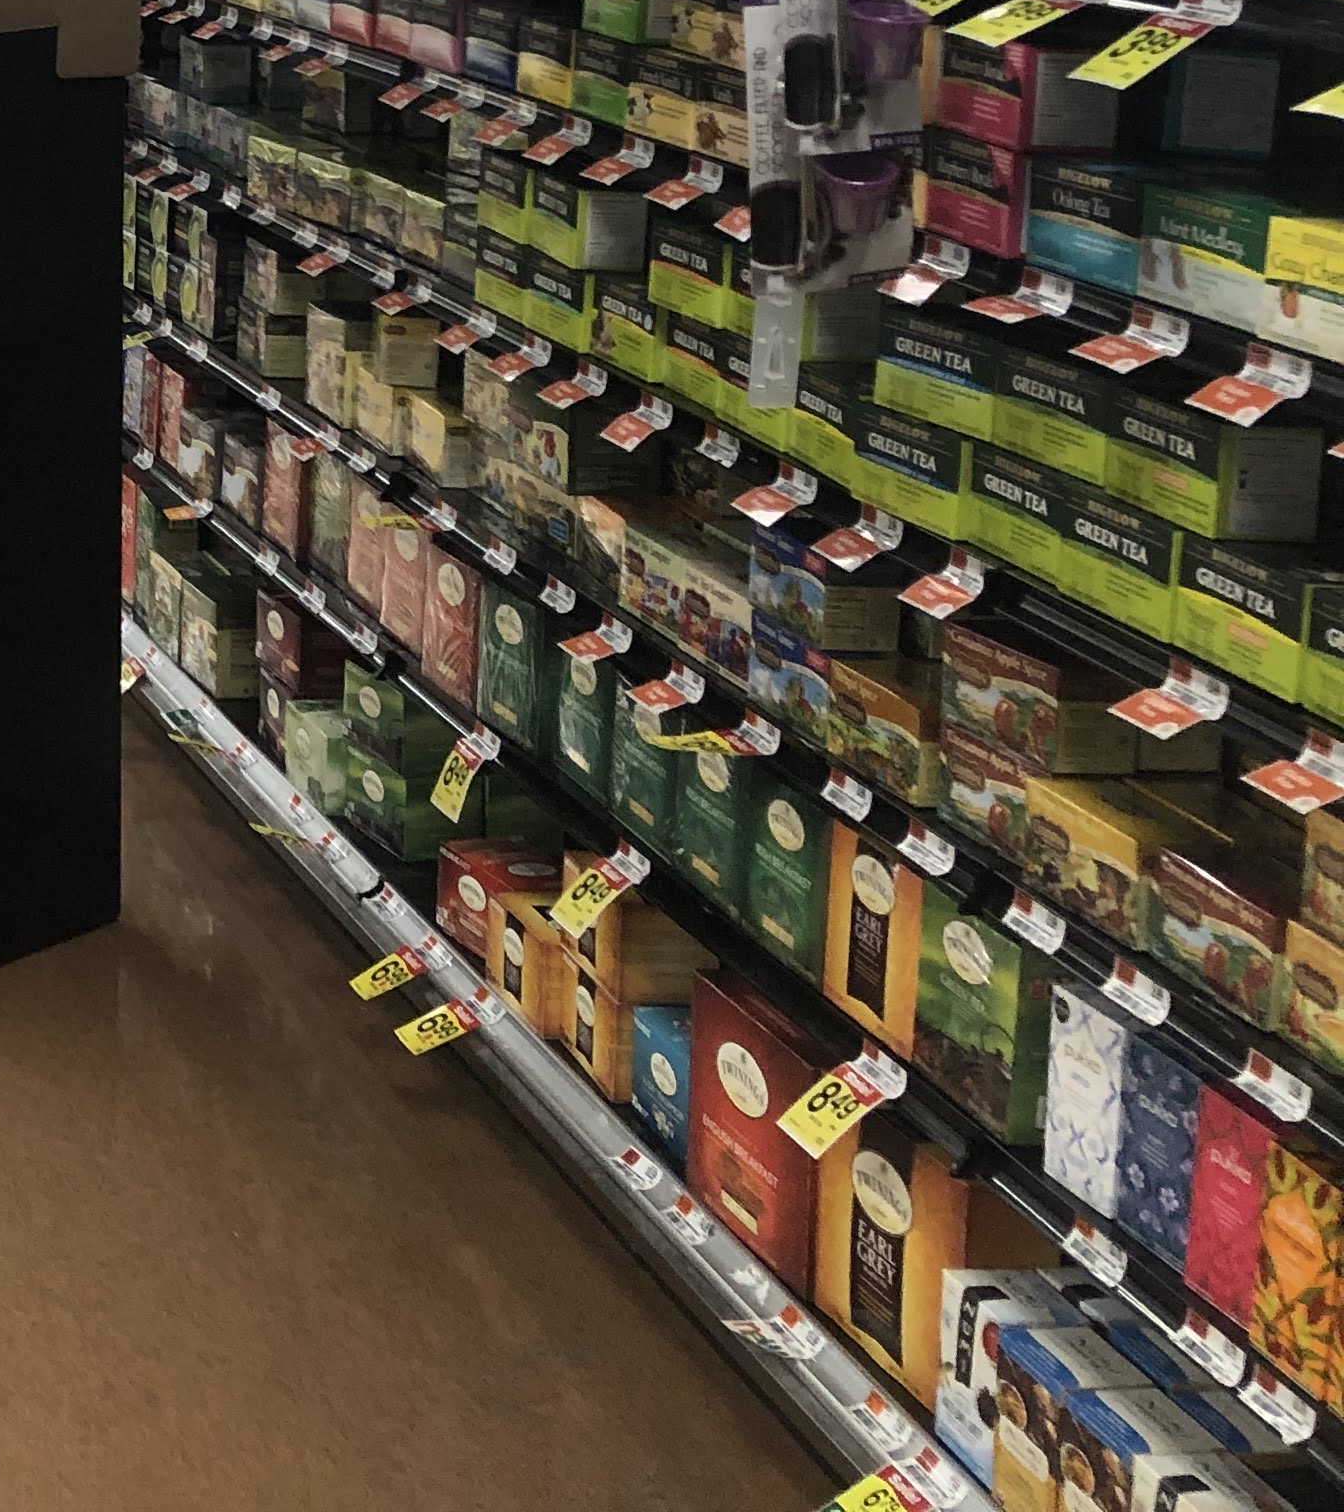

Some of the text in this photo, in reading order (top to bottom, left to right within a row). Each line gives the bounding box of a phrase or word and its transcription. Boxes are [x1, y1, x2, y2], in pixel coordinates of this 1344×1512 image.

[1108, 28, 1181, 59] 399
[659, 242, 709, 272] GREEN TEA
[728, 356, 751, 378] GREE
[895, 335, 973, 375] GREEN TEA
[799, 390, 843, 425] GREEN TEA
[1013, 374, 1085, 416] GREEN TEA
[868, 432, 937, 473] GREEN TEA
[1123, 416, 1196, 462] GREEN TEA
[983, 473, 1049, 518] GREEN TEA
[1074, 518, 1149, 566] GREEN TEA
[1196, 567, 1276, 620] GREEN TEA
[442, 755, 468, 787] 849
[571, 872, 611, 904] 849
[853, 921, 883, 954] GREY
[854, 907, 883, 936] EARL
[806, 1081, 860, 1121] 849
[857, 1218, 897, 1267] EARL
[855, 1240, 897, 1286] GREY
